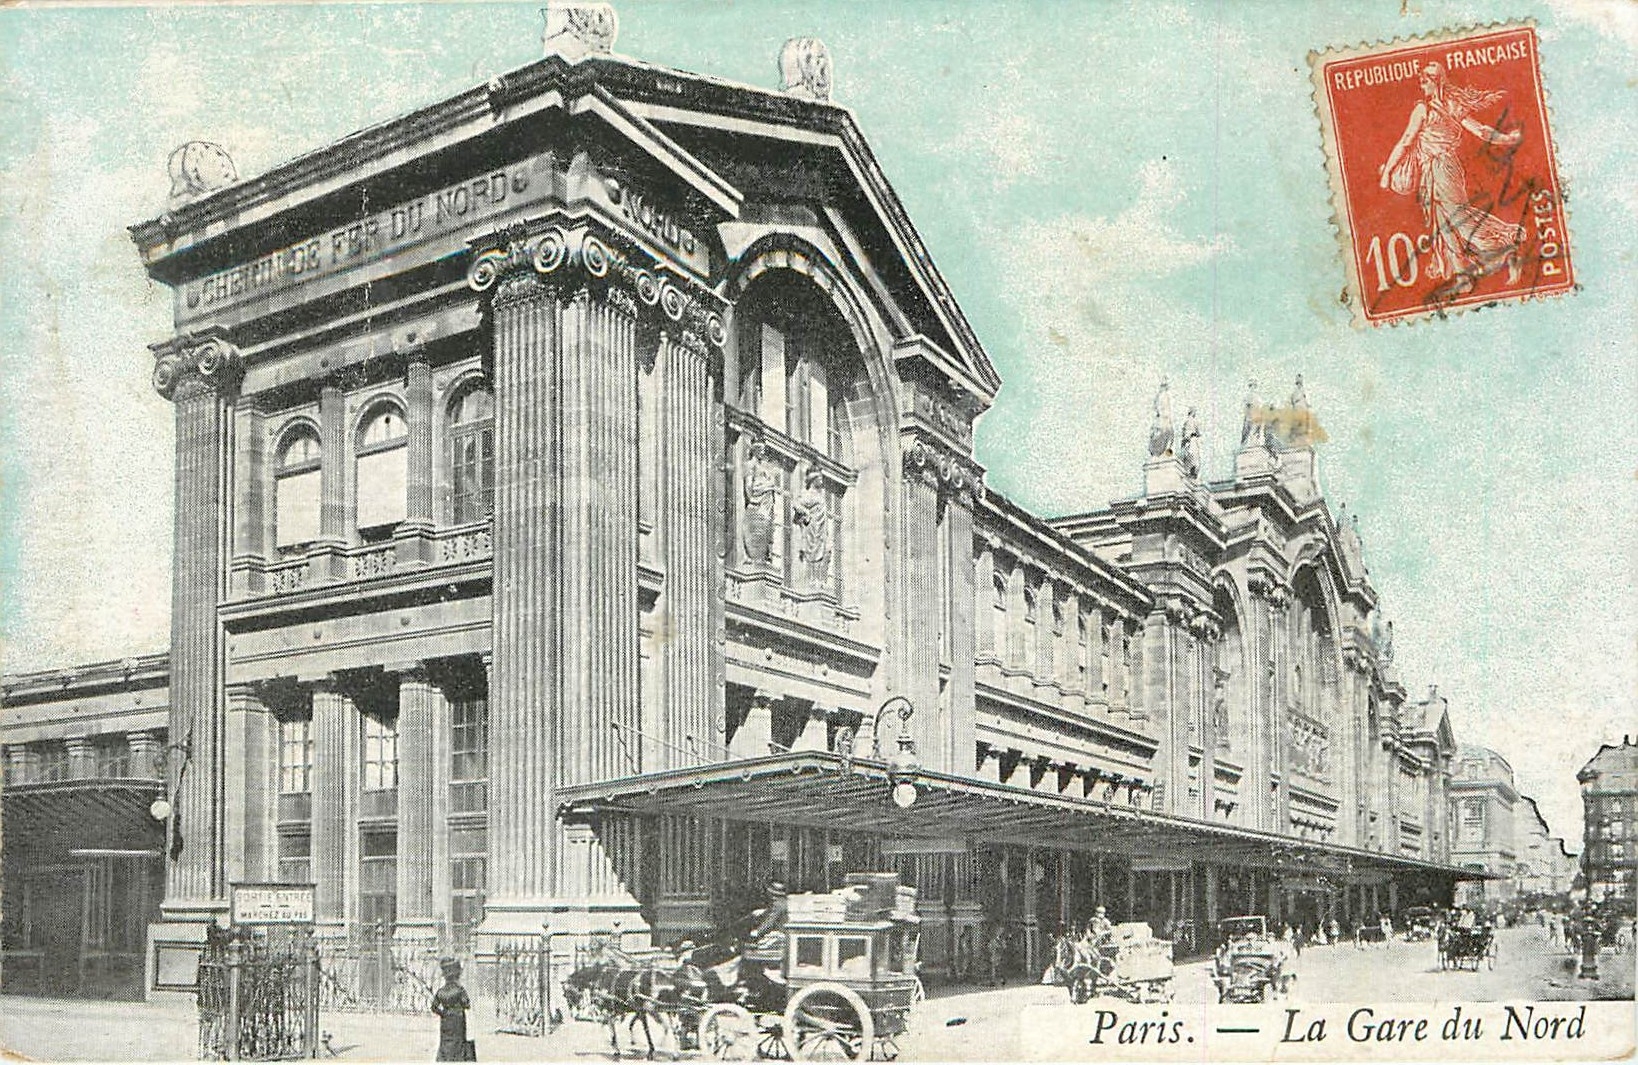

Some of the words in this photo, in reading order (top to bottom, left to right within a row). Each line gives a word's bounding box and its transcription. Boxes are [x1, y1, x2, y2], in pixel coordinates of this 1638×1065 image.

[1446, 41, 1528, 71] FRANÇAISE
[290, 240, 320, 275] DE
[330, 222, 382, 266] FER
[390, 202, 424, 241] DU
[435, 173, 509, 224] NORD
[1530, 189, 1562, 276] POSTES
